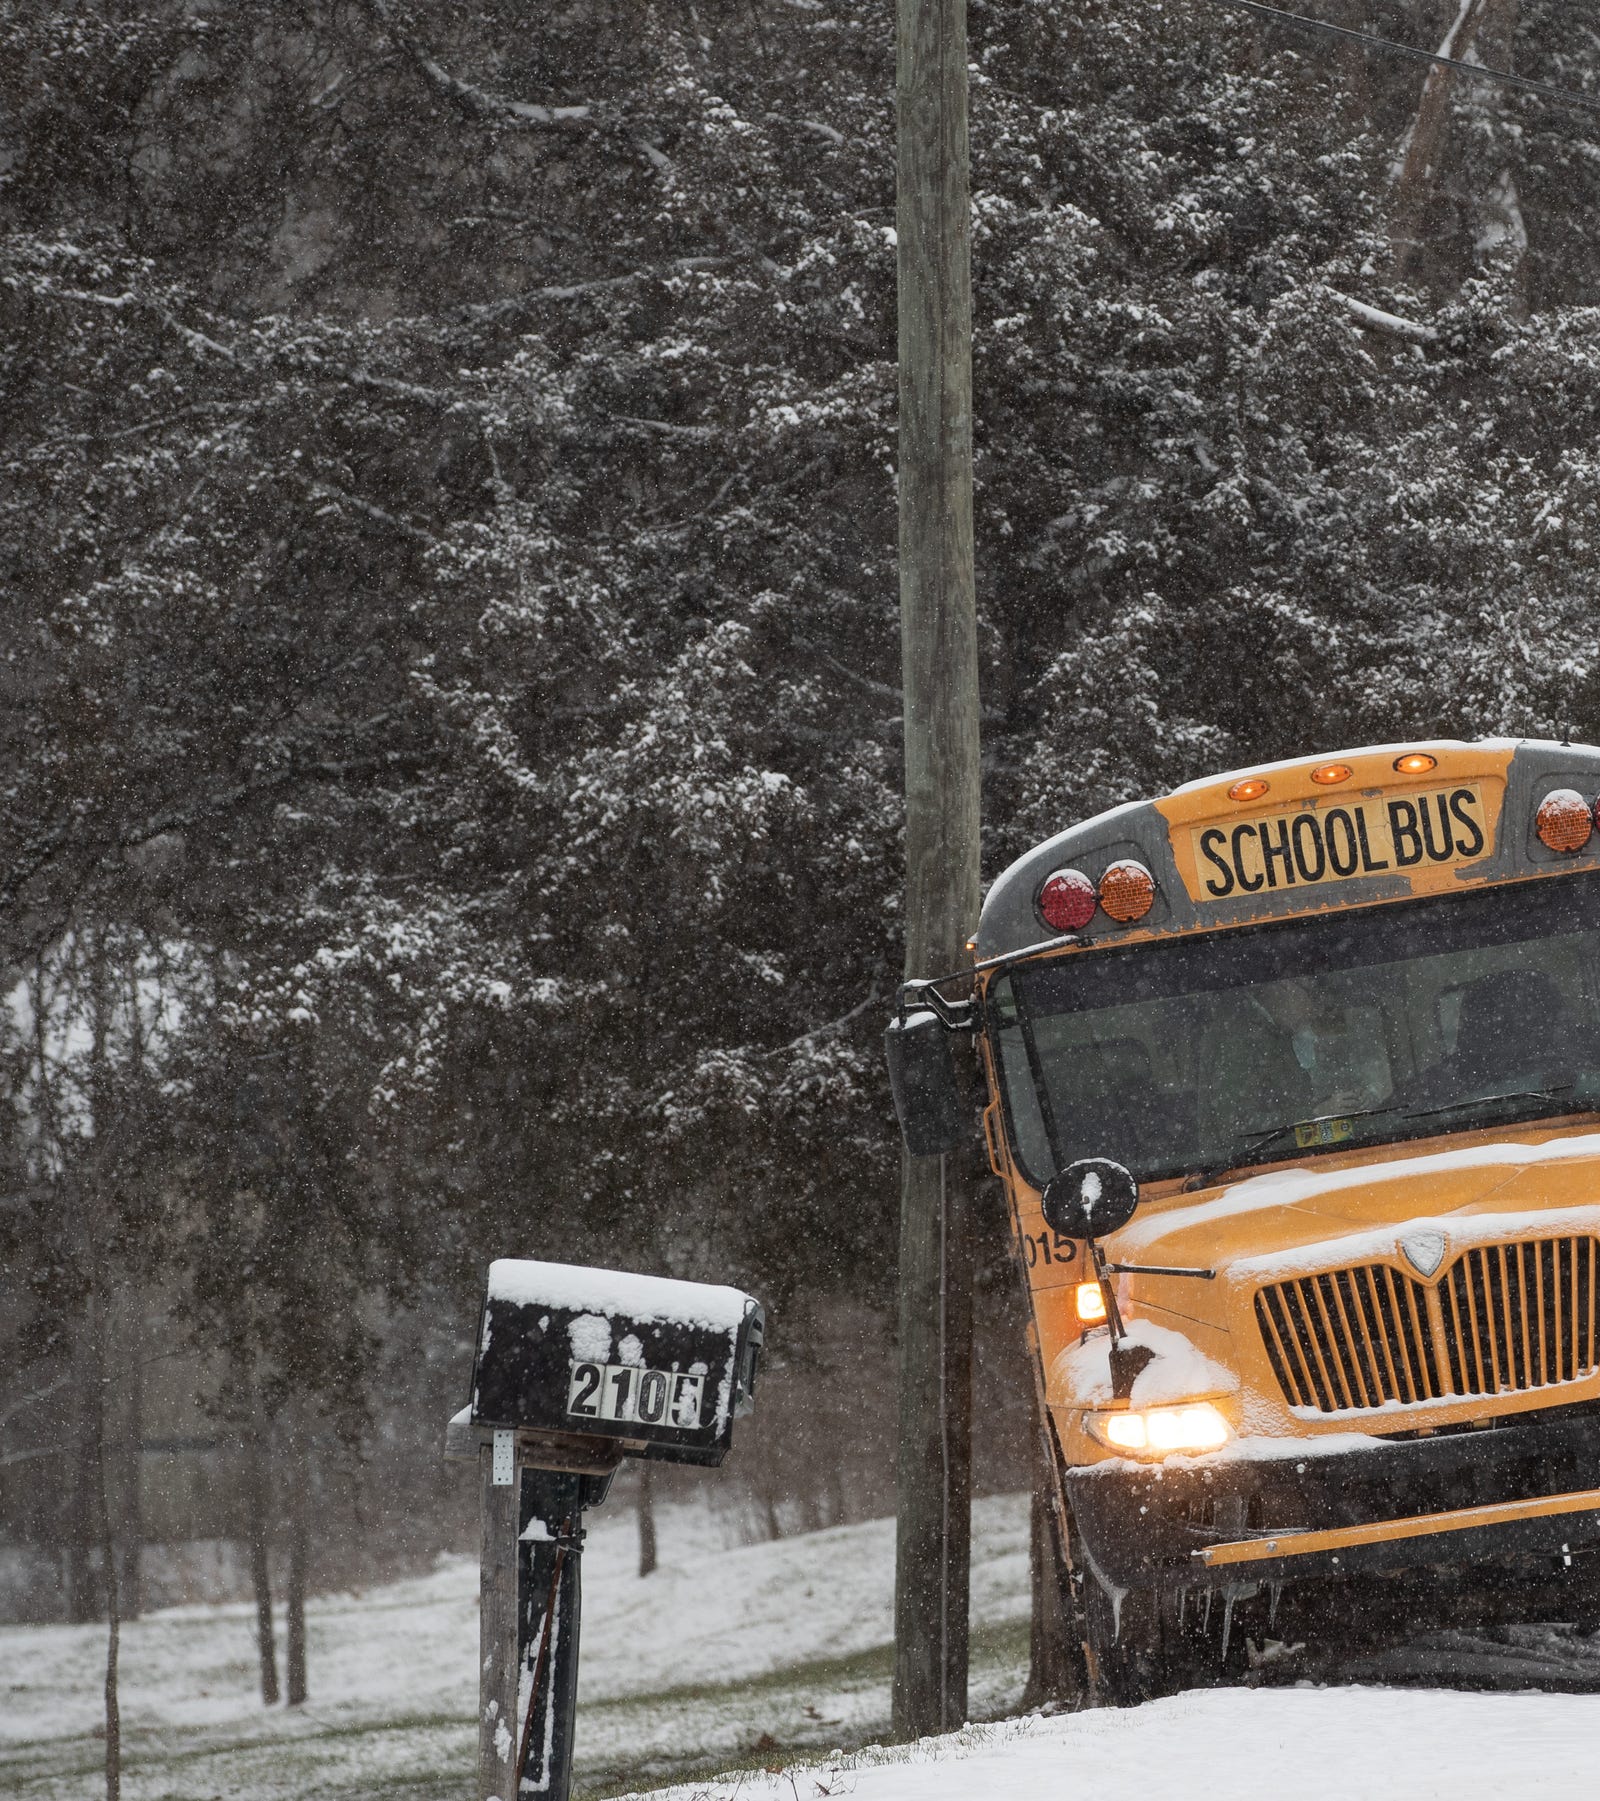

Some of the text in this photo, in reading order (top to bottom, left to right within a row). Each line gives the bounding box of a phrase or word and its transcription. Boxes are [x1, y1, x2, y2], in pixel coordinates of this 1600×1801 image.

[1200, 789, 1485, 897] SCHOOL BUS
[570, 1363, 699, 1427] 2105
